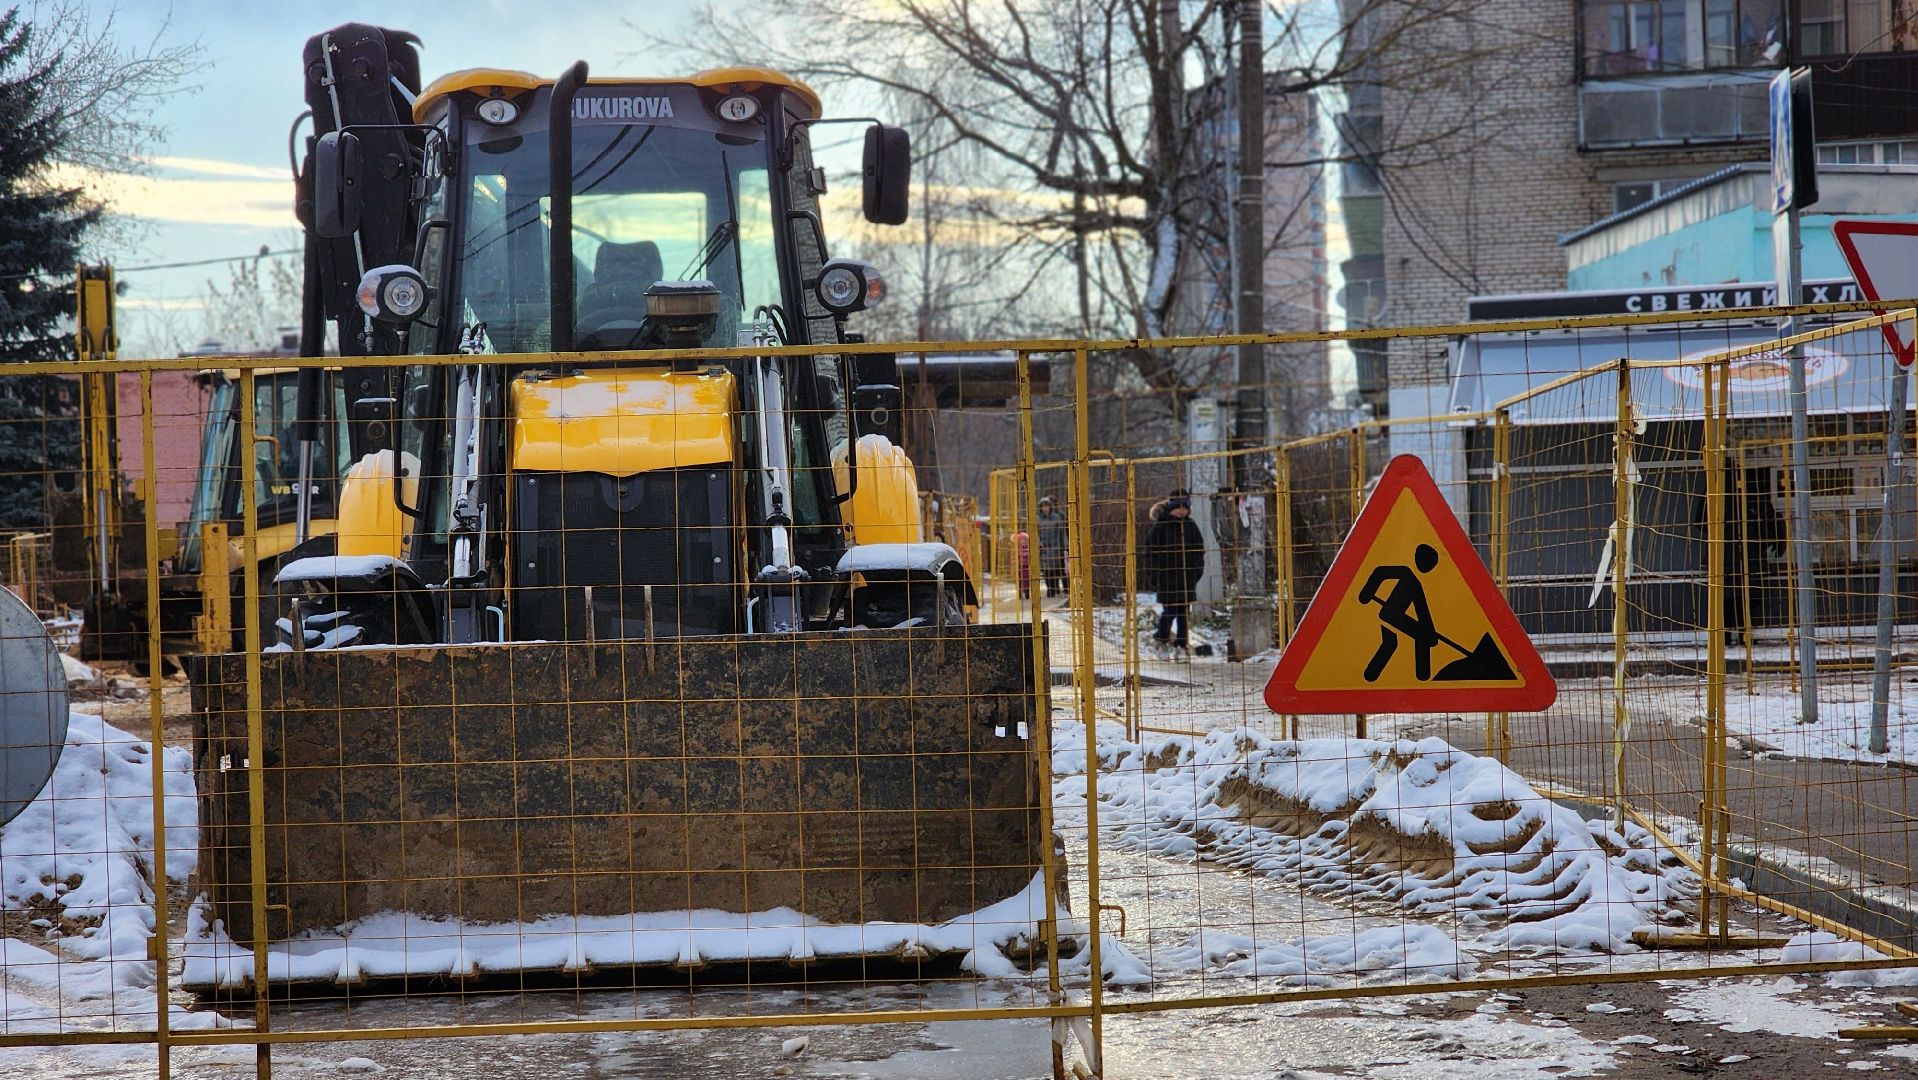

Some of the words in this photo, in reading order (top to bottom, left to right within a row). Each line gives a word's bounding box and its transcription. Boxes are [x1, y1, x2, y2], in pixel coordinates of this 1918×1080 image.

[571, 97, 674, 119] UKUROVA
[1626, 286, 1778, 313] СВЕЖИЙ
[1812, 285, 1857, 303] ХЛ
[271, 483, 320, 495] WB9R
